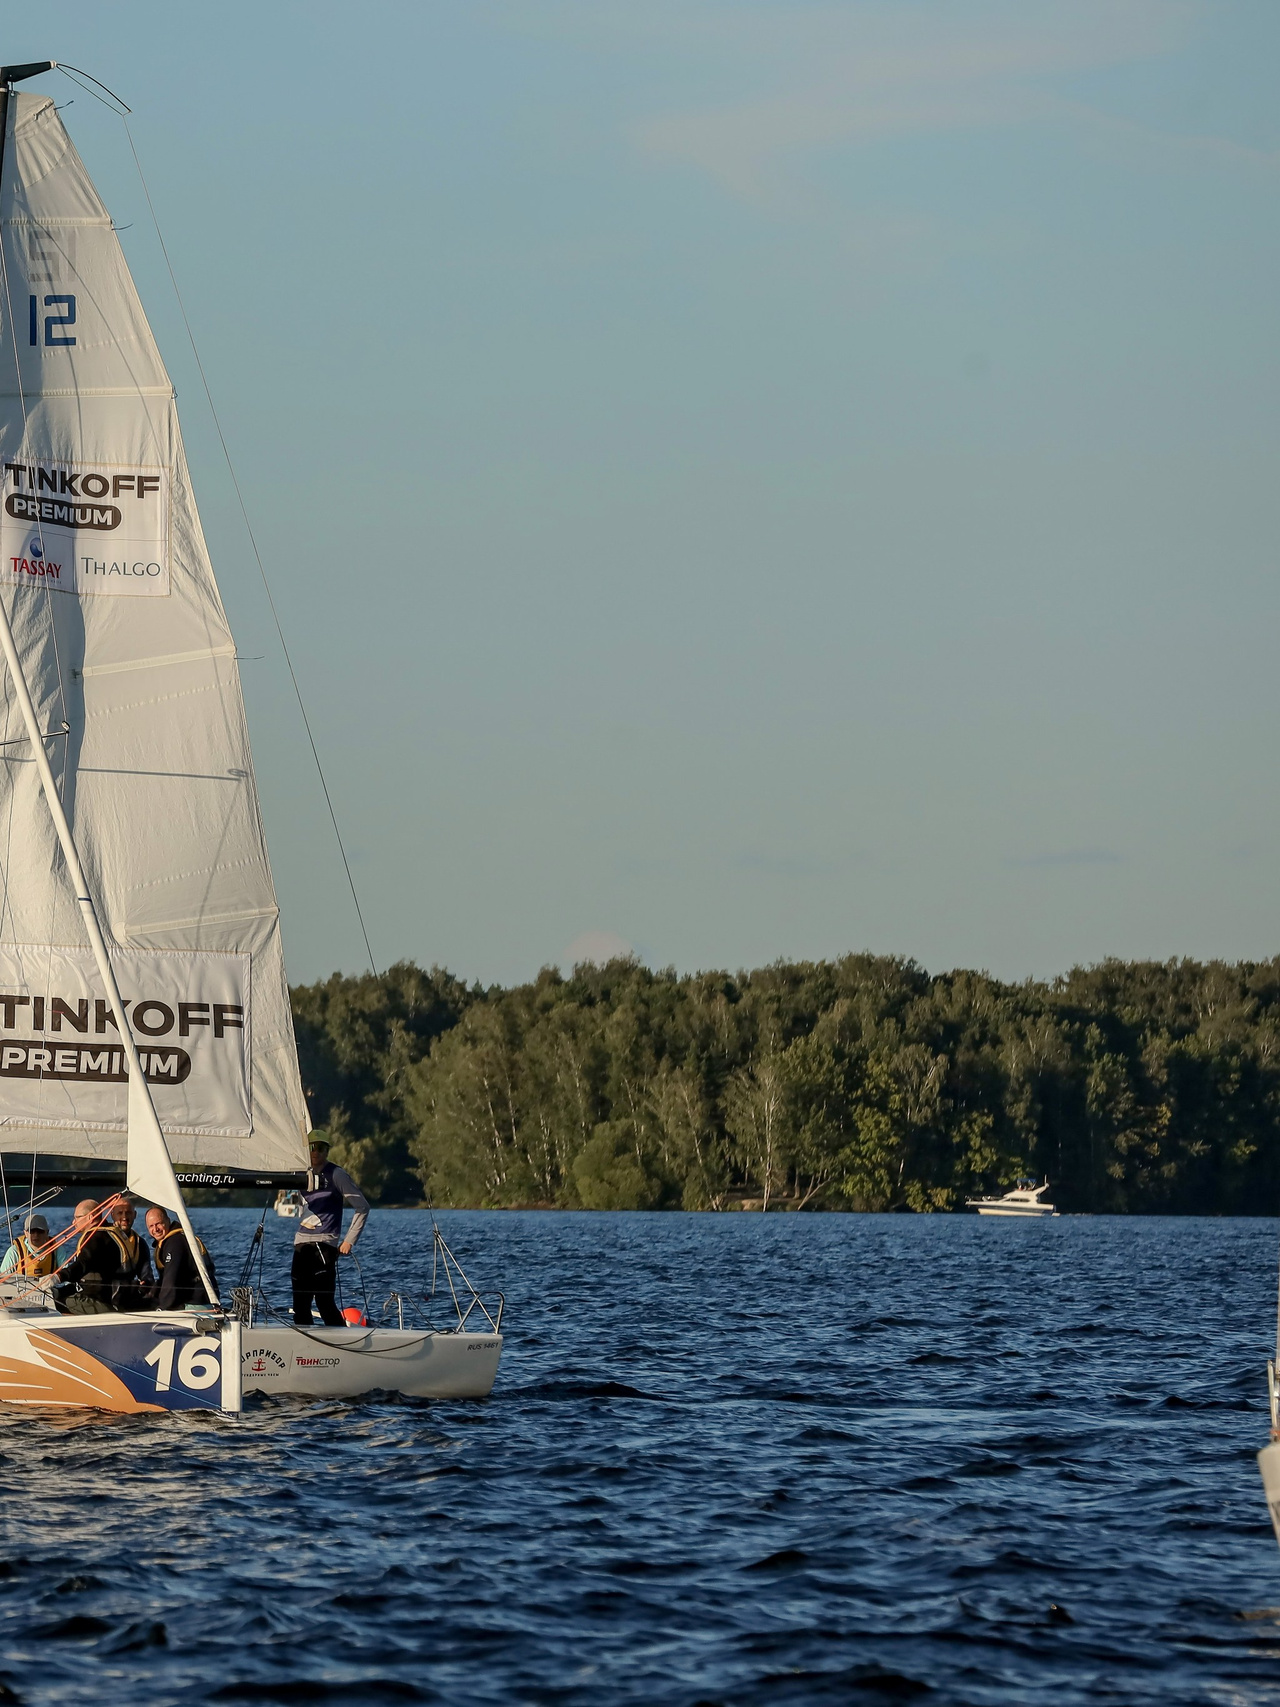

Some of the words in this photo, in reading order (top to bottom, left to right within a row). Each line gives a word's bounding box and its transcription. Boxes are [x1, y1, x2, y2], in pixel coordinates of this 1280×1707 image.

[28, 294, 77, 347] 12
[5, 463, 160, 499] TINKOFF
[13, 498, 113, 526] PREMIUM
[9, 557, 63, 579] TASSAY
[1, 1046, 179, 1078] PREMIUM
[144, 1336, 222, 1392] 16
